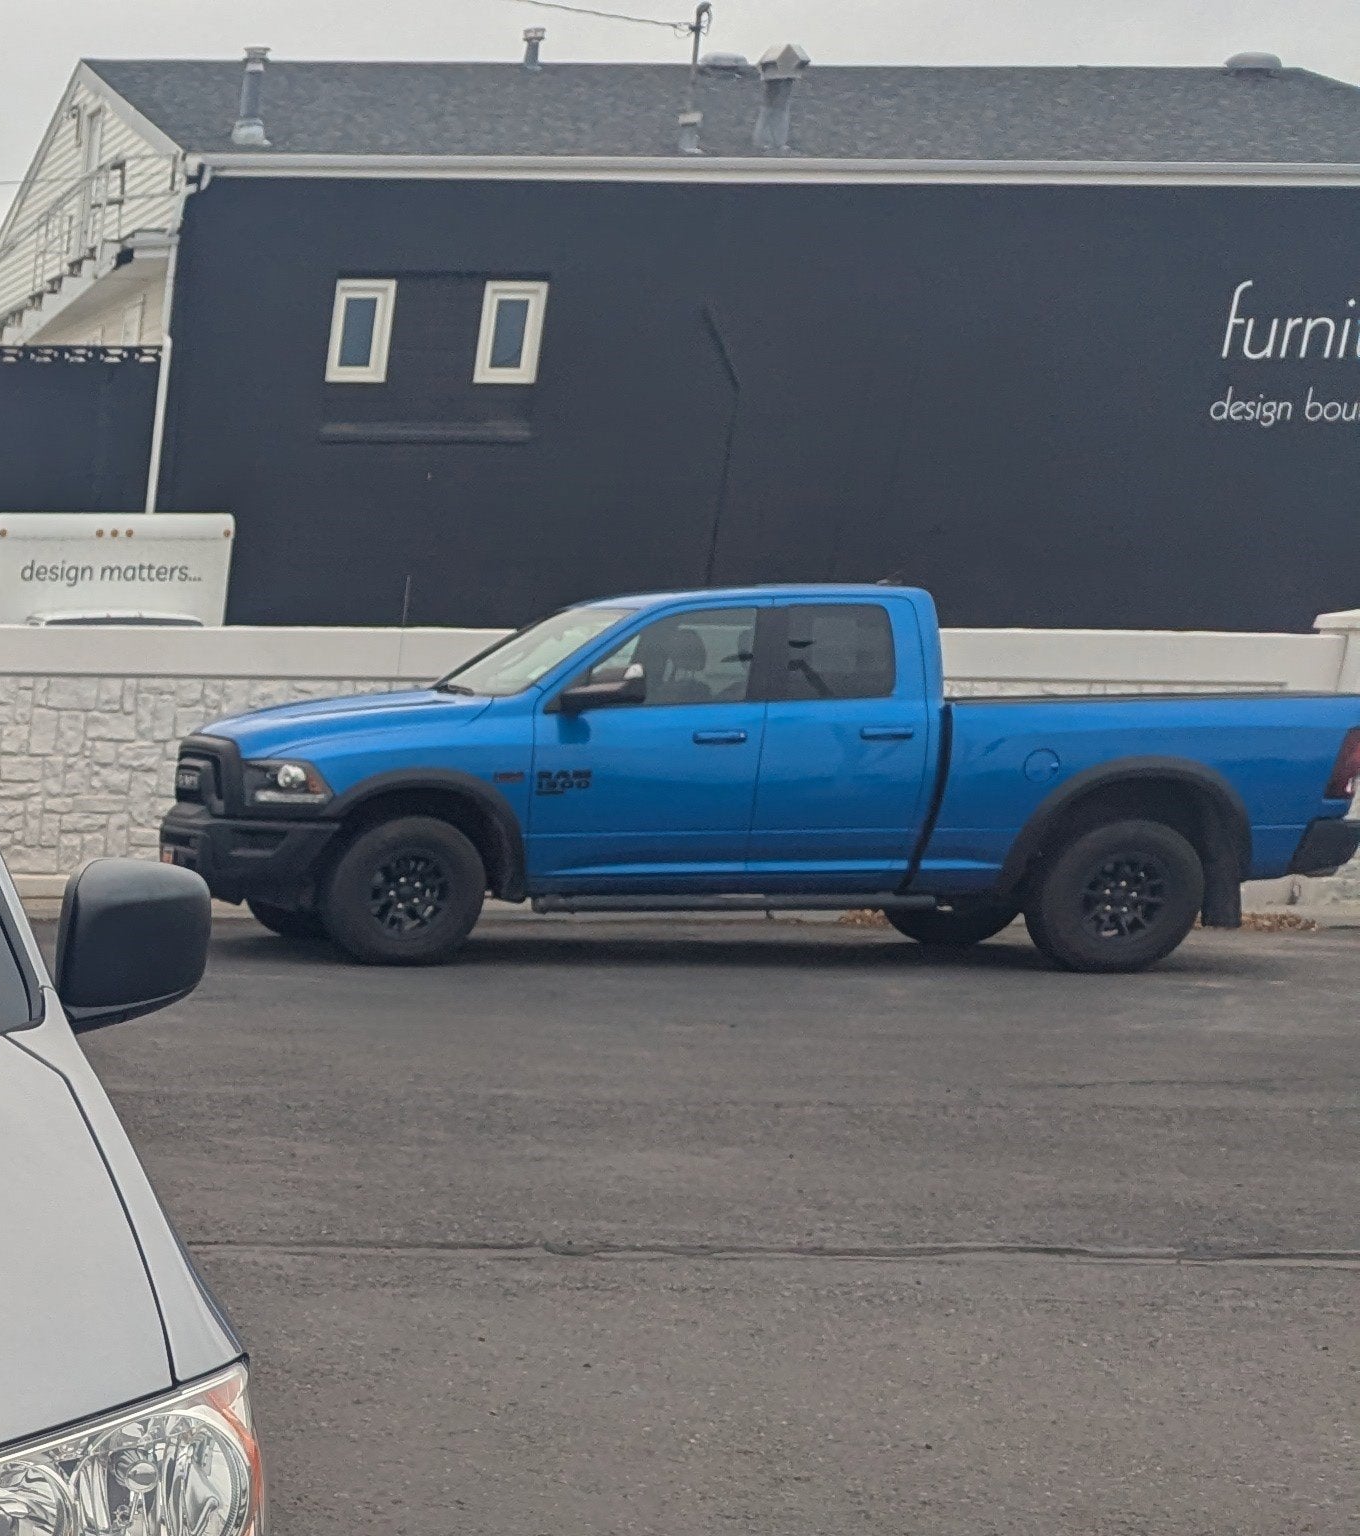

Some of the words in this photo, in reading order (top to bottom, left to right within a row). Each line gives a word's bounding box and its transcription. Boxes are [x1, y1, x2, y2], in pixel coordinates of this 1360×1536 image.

[1221, 280, 1360, 359] furni
[1209, 386, 1293, 427] design
[1304, 386, 1360, 422] bou
[20, 559, 93, 587] design
[99, 562, 202, 583] matters...
